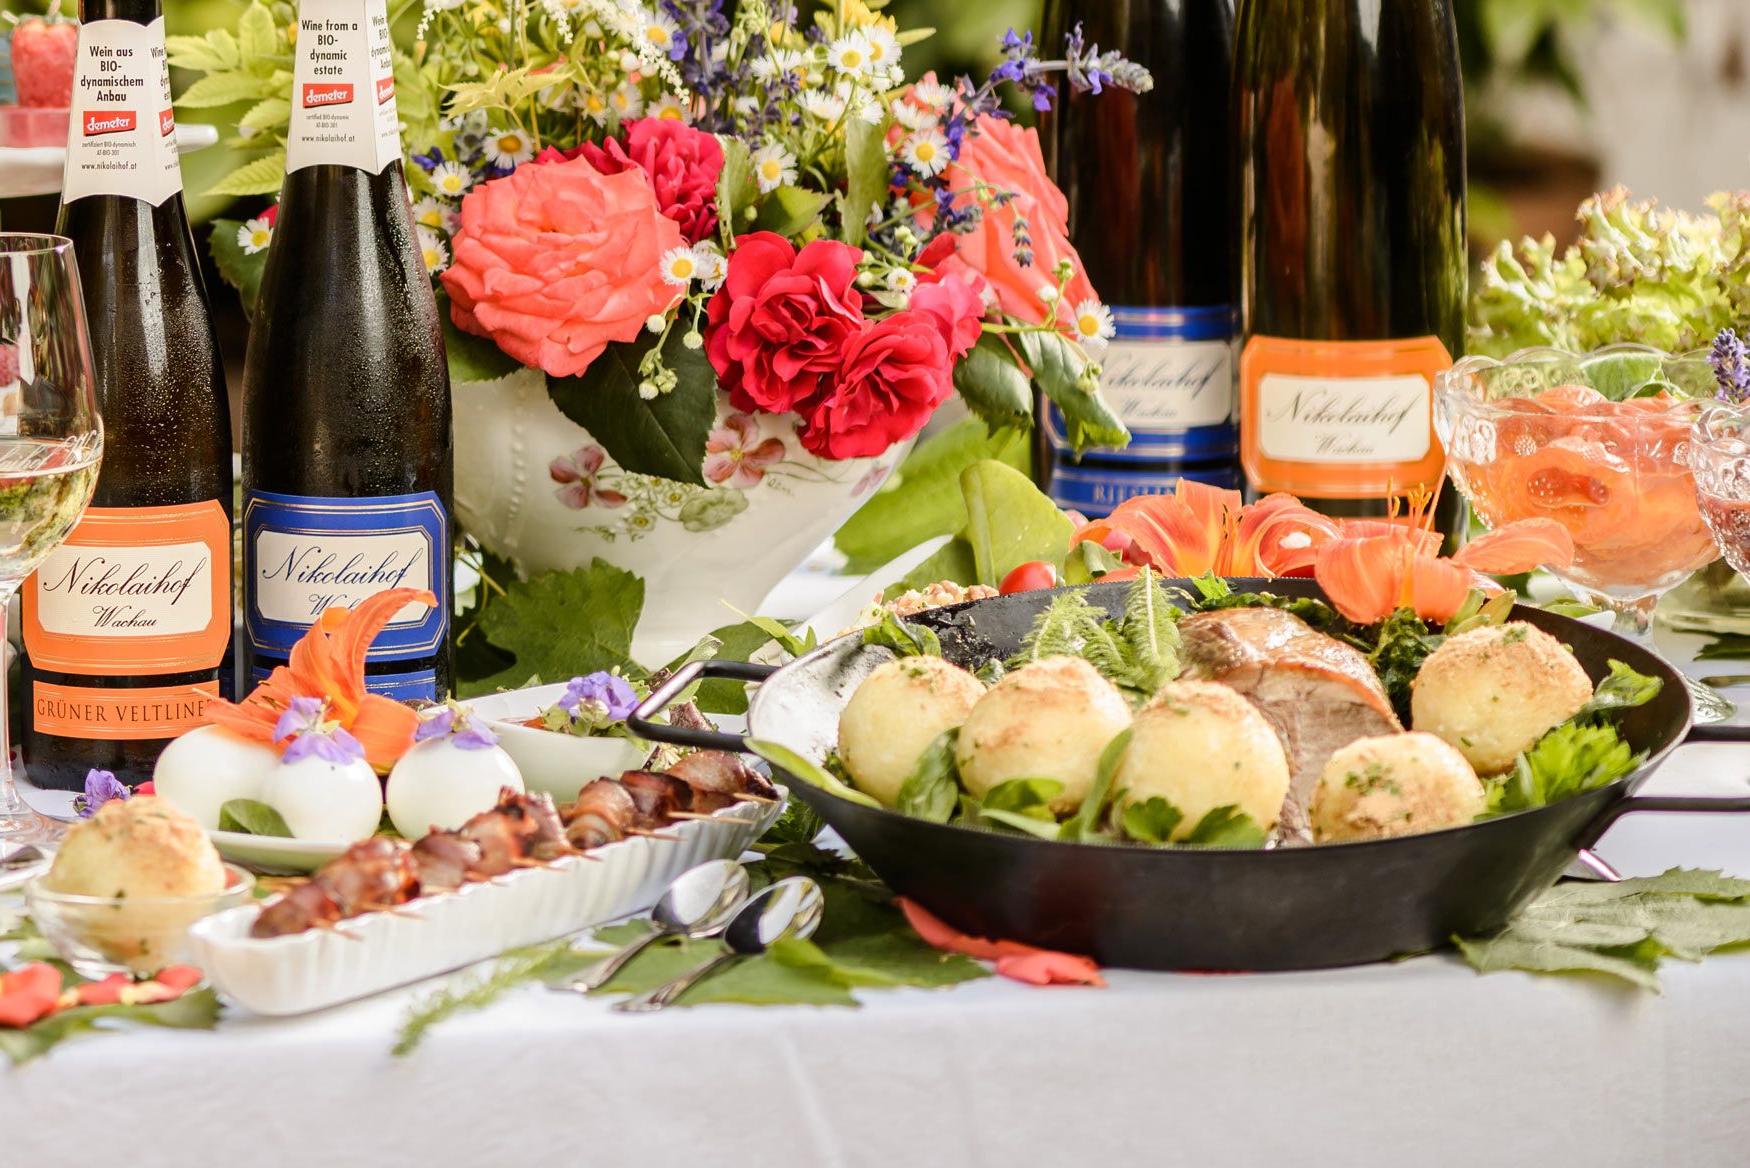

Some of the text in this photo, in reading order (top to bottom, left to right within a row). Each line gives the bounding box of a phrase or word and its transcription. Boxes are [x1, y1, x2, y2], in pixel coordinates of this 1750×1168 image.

[302, 19, 358, 31] Wine from a
[317, 34, 338, 46] BIO-
[90, 45, 133, 57] Wein aus
[310, 49, 348, 61] dynamic
[100, 60, 122, 72] BIO-
[313, 65, 343, 75] estate
[80, 75, 144, 90] dynamischem
[96, 90, 127, 102] Anbau
[306, 88, 348, 104] demeter
[86, 115, 131, 132] demeter
[301, 134, 355, 143] www.nikolaihof.at
[81, 161, 137, 170] www.nikolaihof.at
[262, 545, 424, 589] Nikolaihof
[43, 556, 207, 606] Nikolaihof
[92, 605, 159, 629] Wachau
[37, 698, 213, 722] GRÜNER VELTLINE
